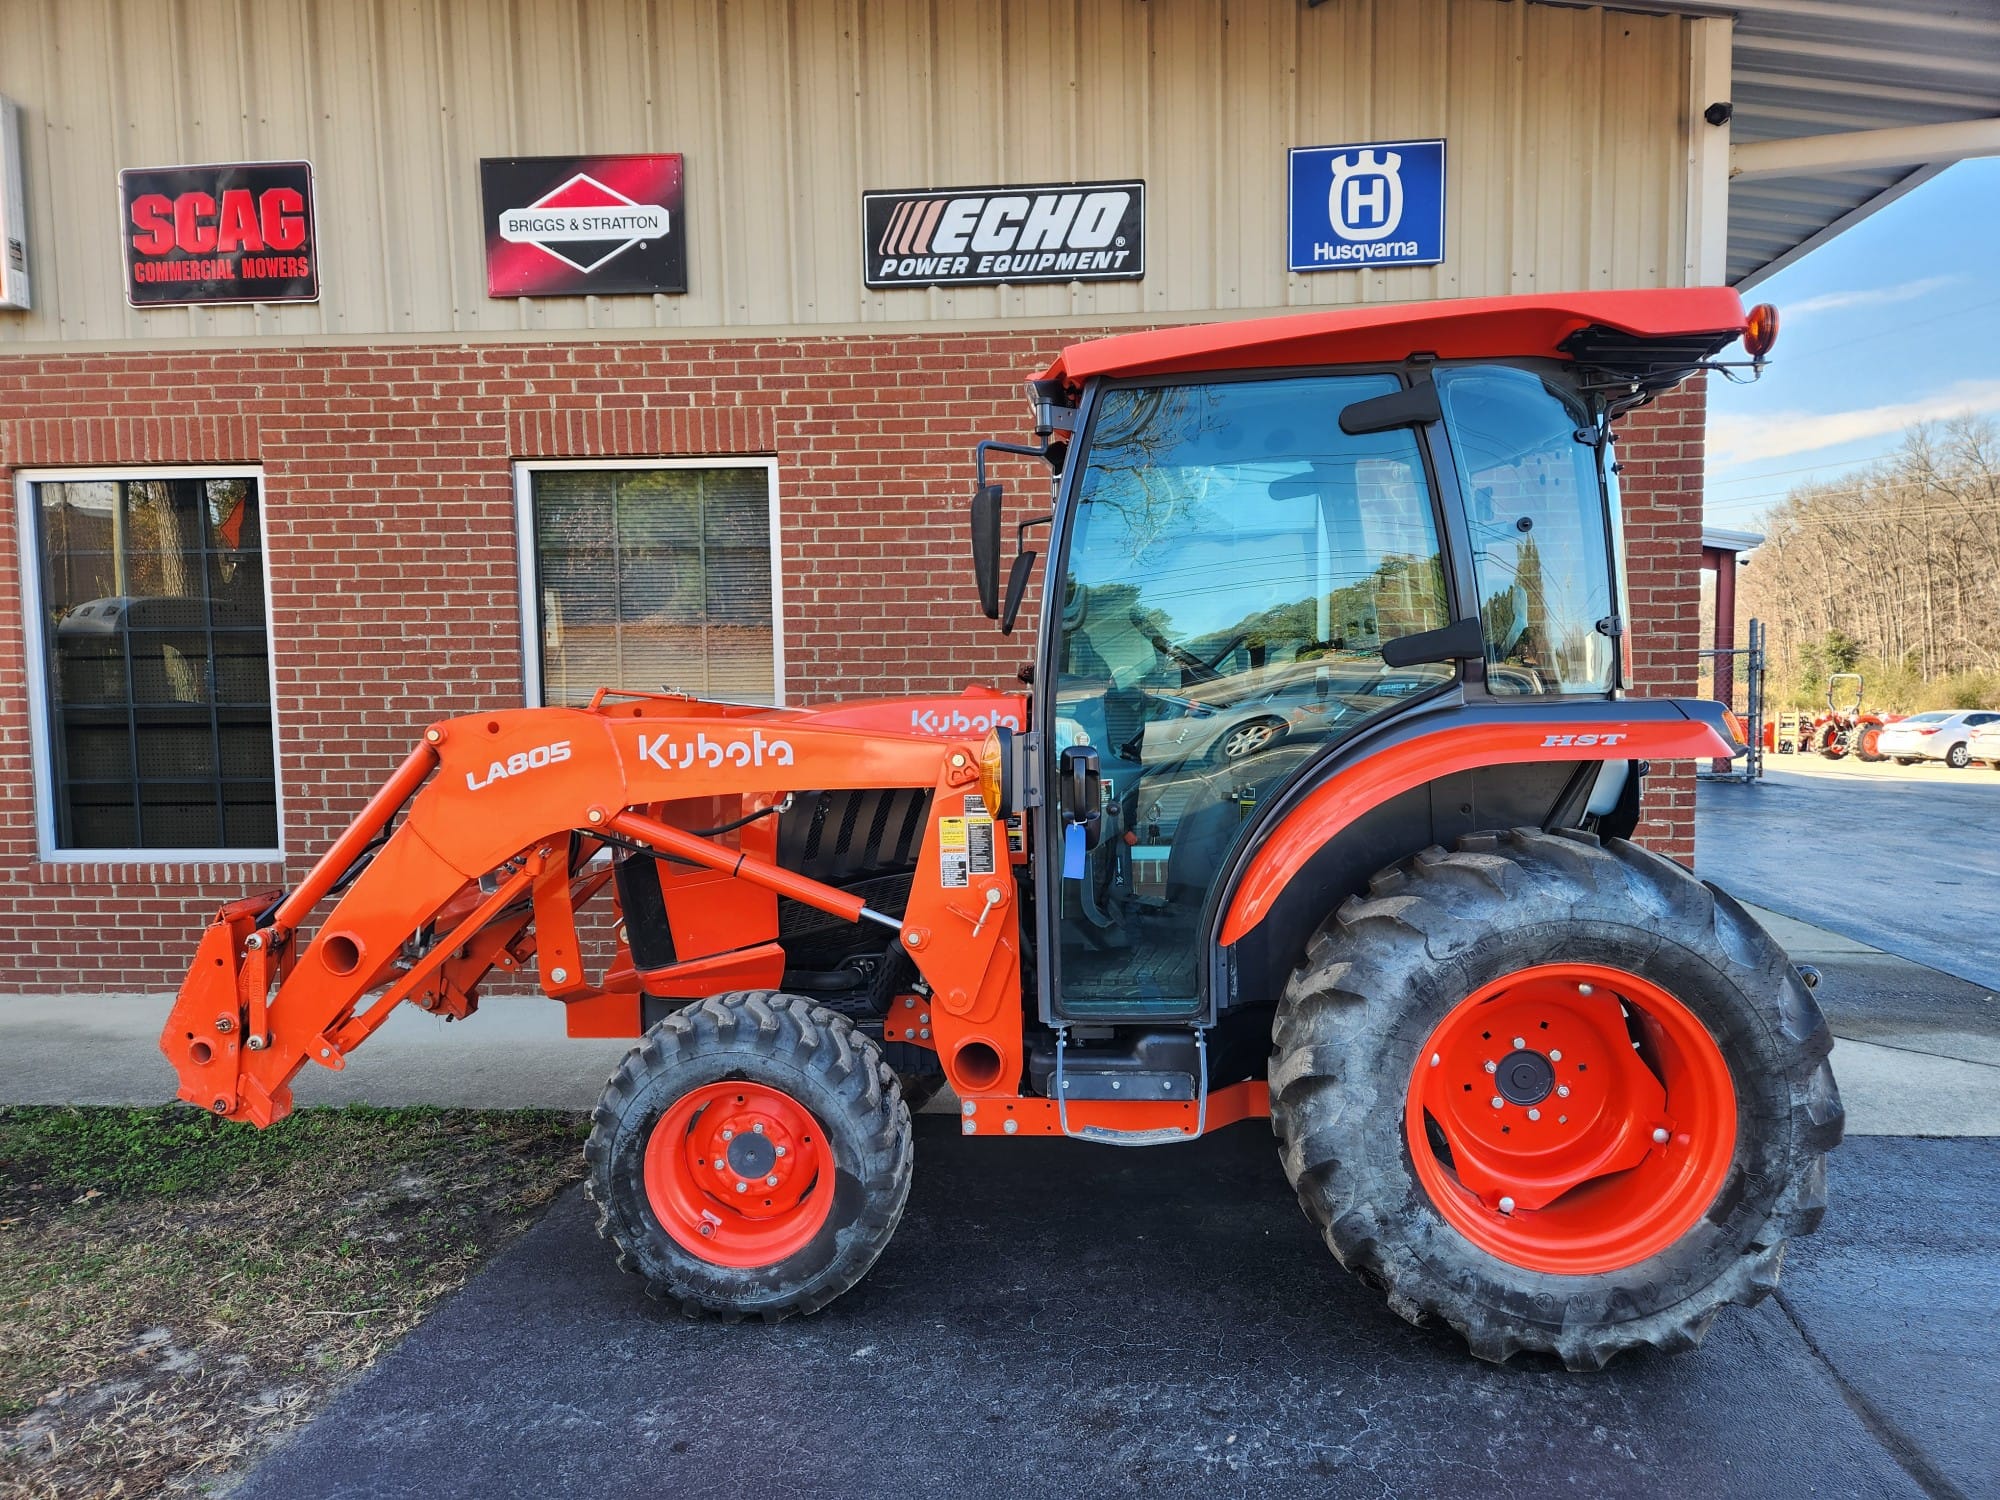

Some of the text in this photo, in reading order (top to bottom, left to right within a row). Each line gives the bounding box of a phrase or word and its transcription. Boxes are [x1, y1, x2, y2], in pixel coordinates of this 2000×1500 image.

[131, 187, 306, 255] SCAG
[508, 215, 659, 233] BRIGGS & STRATTON
[931, 191, 1131, 254] ECHO
[879, 250, 1130, 277] POWER EQUIPMENT
[1313, 241, 1418, 262] Husqvarna
[134, 256, 309, 283] COMMERCIAL MOWERS
[911, 708, 1020, 733] Kubota
[637, 730, 795, 770] Kubota
[1540, 733, 1627, 747] HST
[465, 740, 572, 791] LA805
